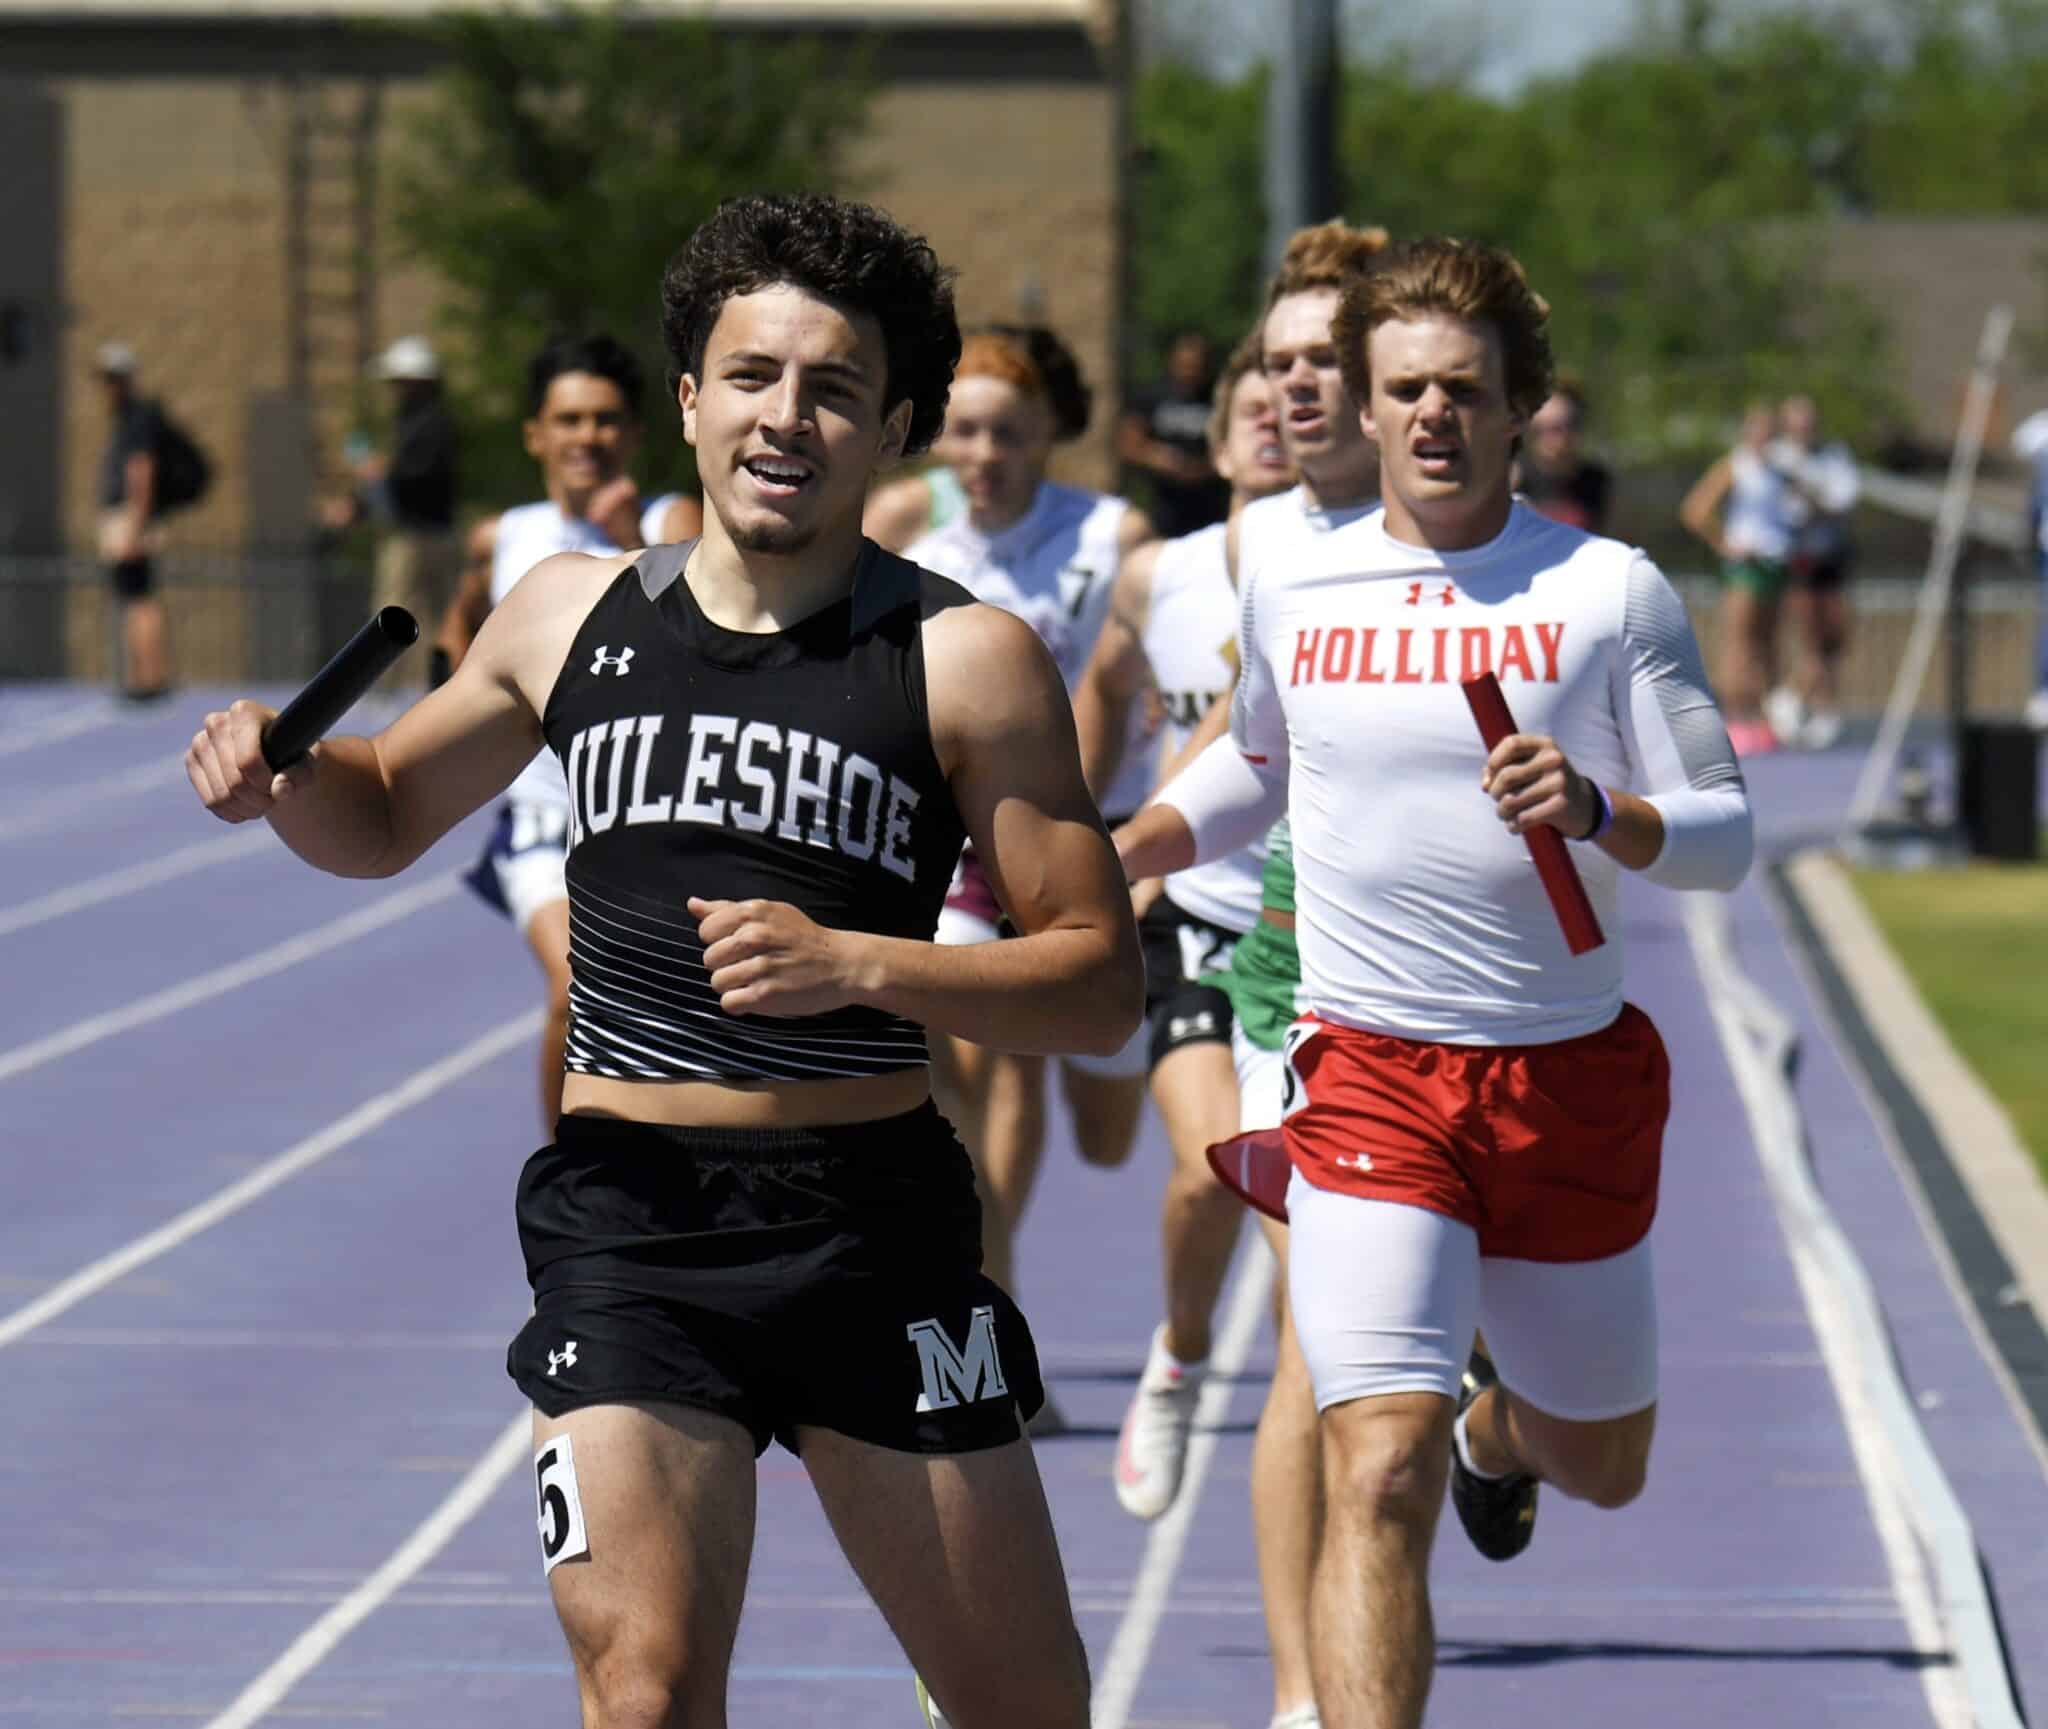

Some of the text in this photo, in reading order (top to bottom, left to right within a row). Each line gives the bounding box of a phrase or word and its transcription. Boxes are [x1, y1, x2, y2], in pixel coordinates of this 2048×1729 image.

[1288, 621, 1566, 687] HOLLIDAY
[907, 1305, 1009, 1412] M
[536, 1447, 570, 1560] 5
